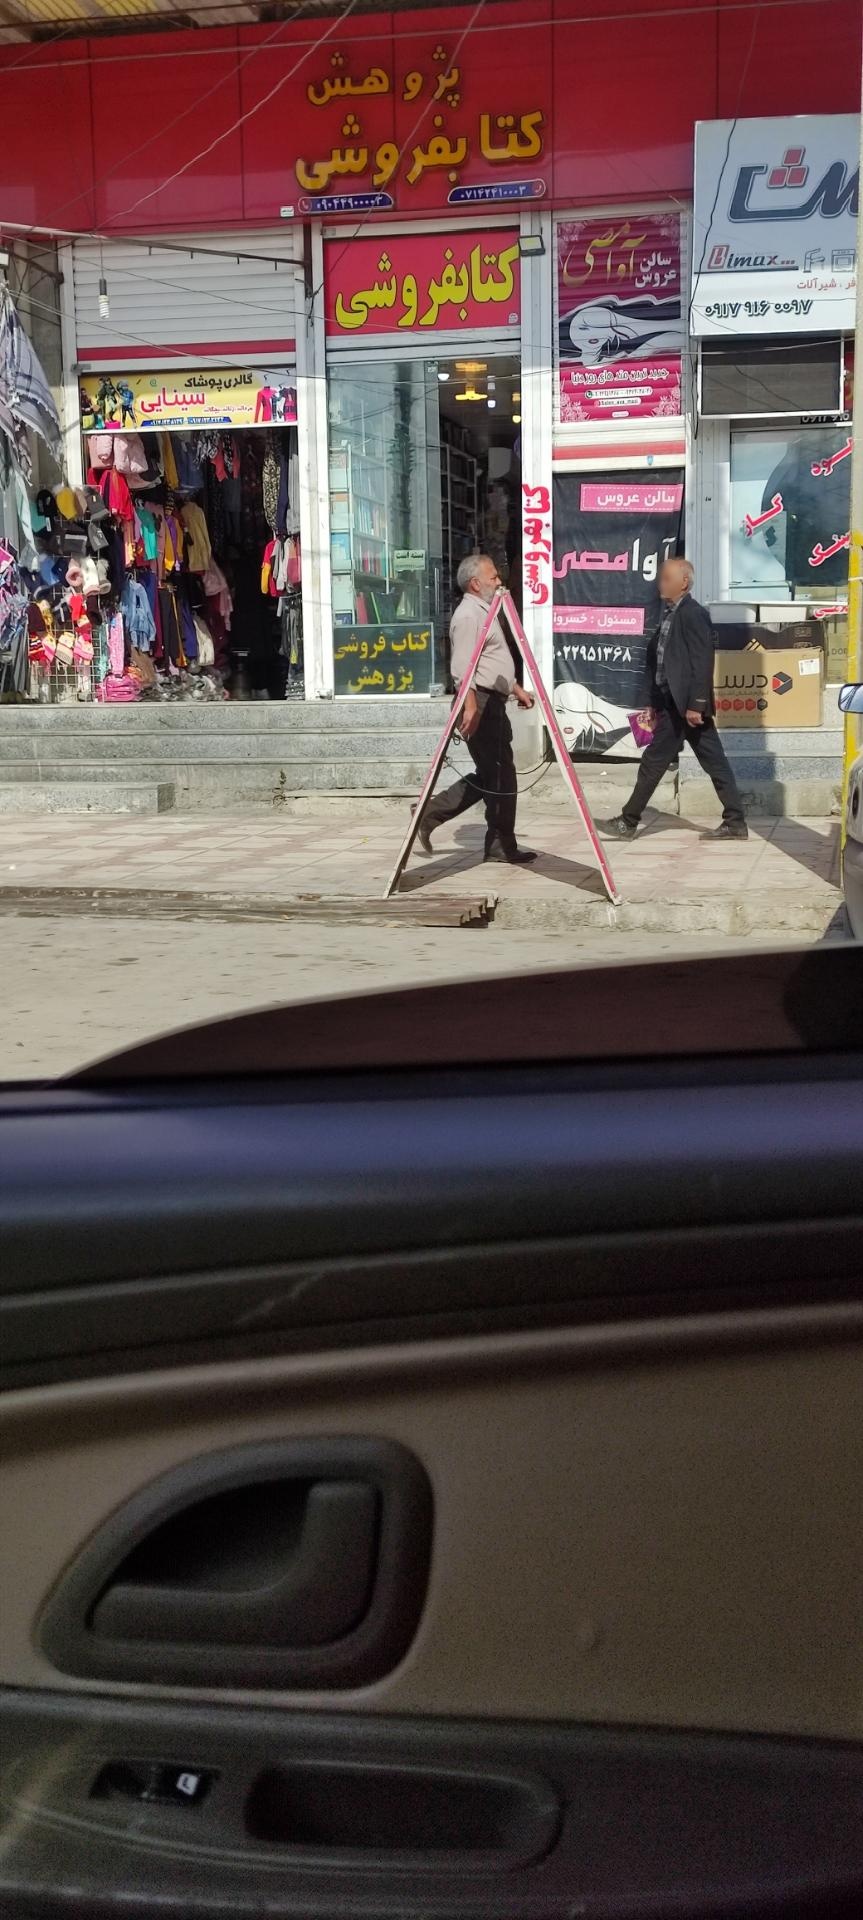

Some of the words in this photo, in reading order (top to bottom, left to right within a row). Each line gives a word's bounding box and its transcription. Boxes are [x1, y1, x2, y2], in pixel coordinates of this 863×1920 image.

[640, 251, 672, 273] سالن
[335, 243, 521, 329] کتابفروشی
[635, 269, 677, 288] عروس
[183, 375, 223, 393] پوشاک
[223, 373, 253, 389] گالری
[140, 388, 206, 413] سینایی
[597, 492, 640, 507] عروس
[644, 491, 675, 507] سالن
[597, 614, 637, 627] مسئول
[334, 631, 387, 660] فروشی
[391, 631, 430, 654] کتاب
[347, 666, 415, 693] پژوهش
